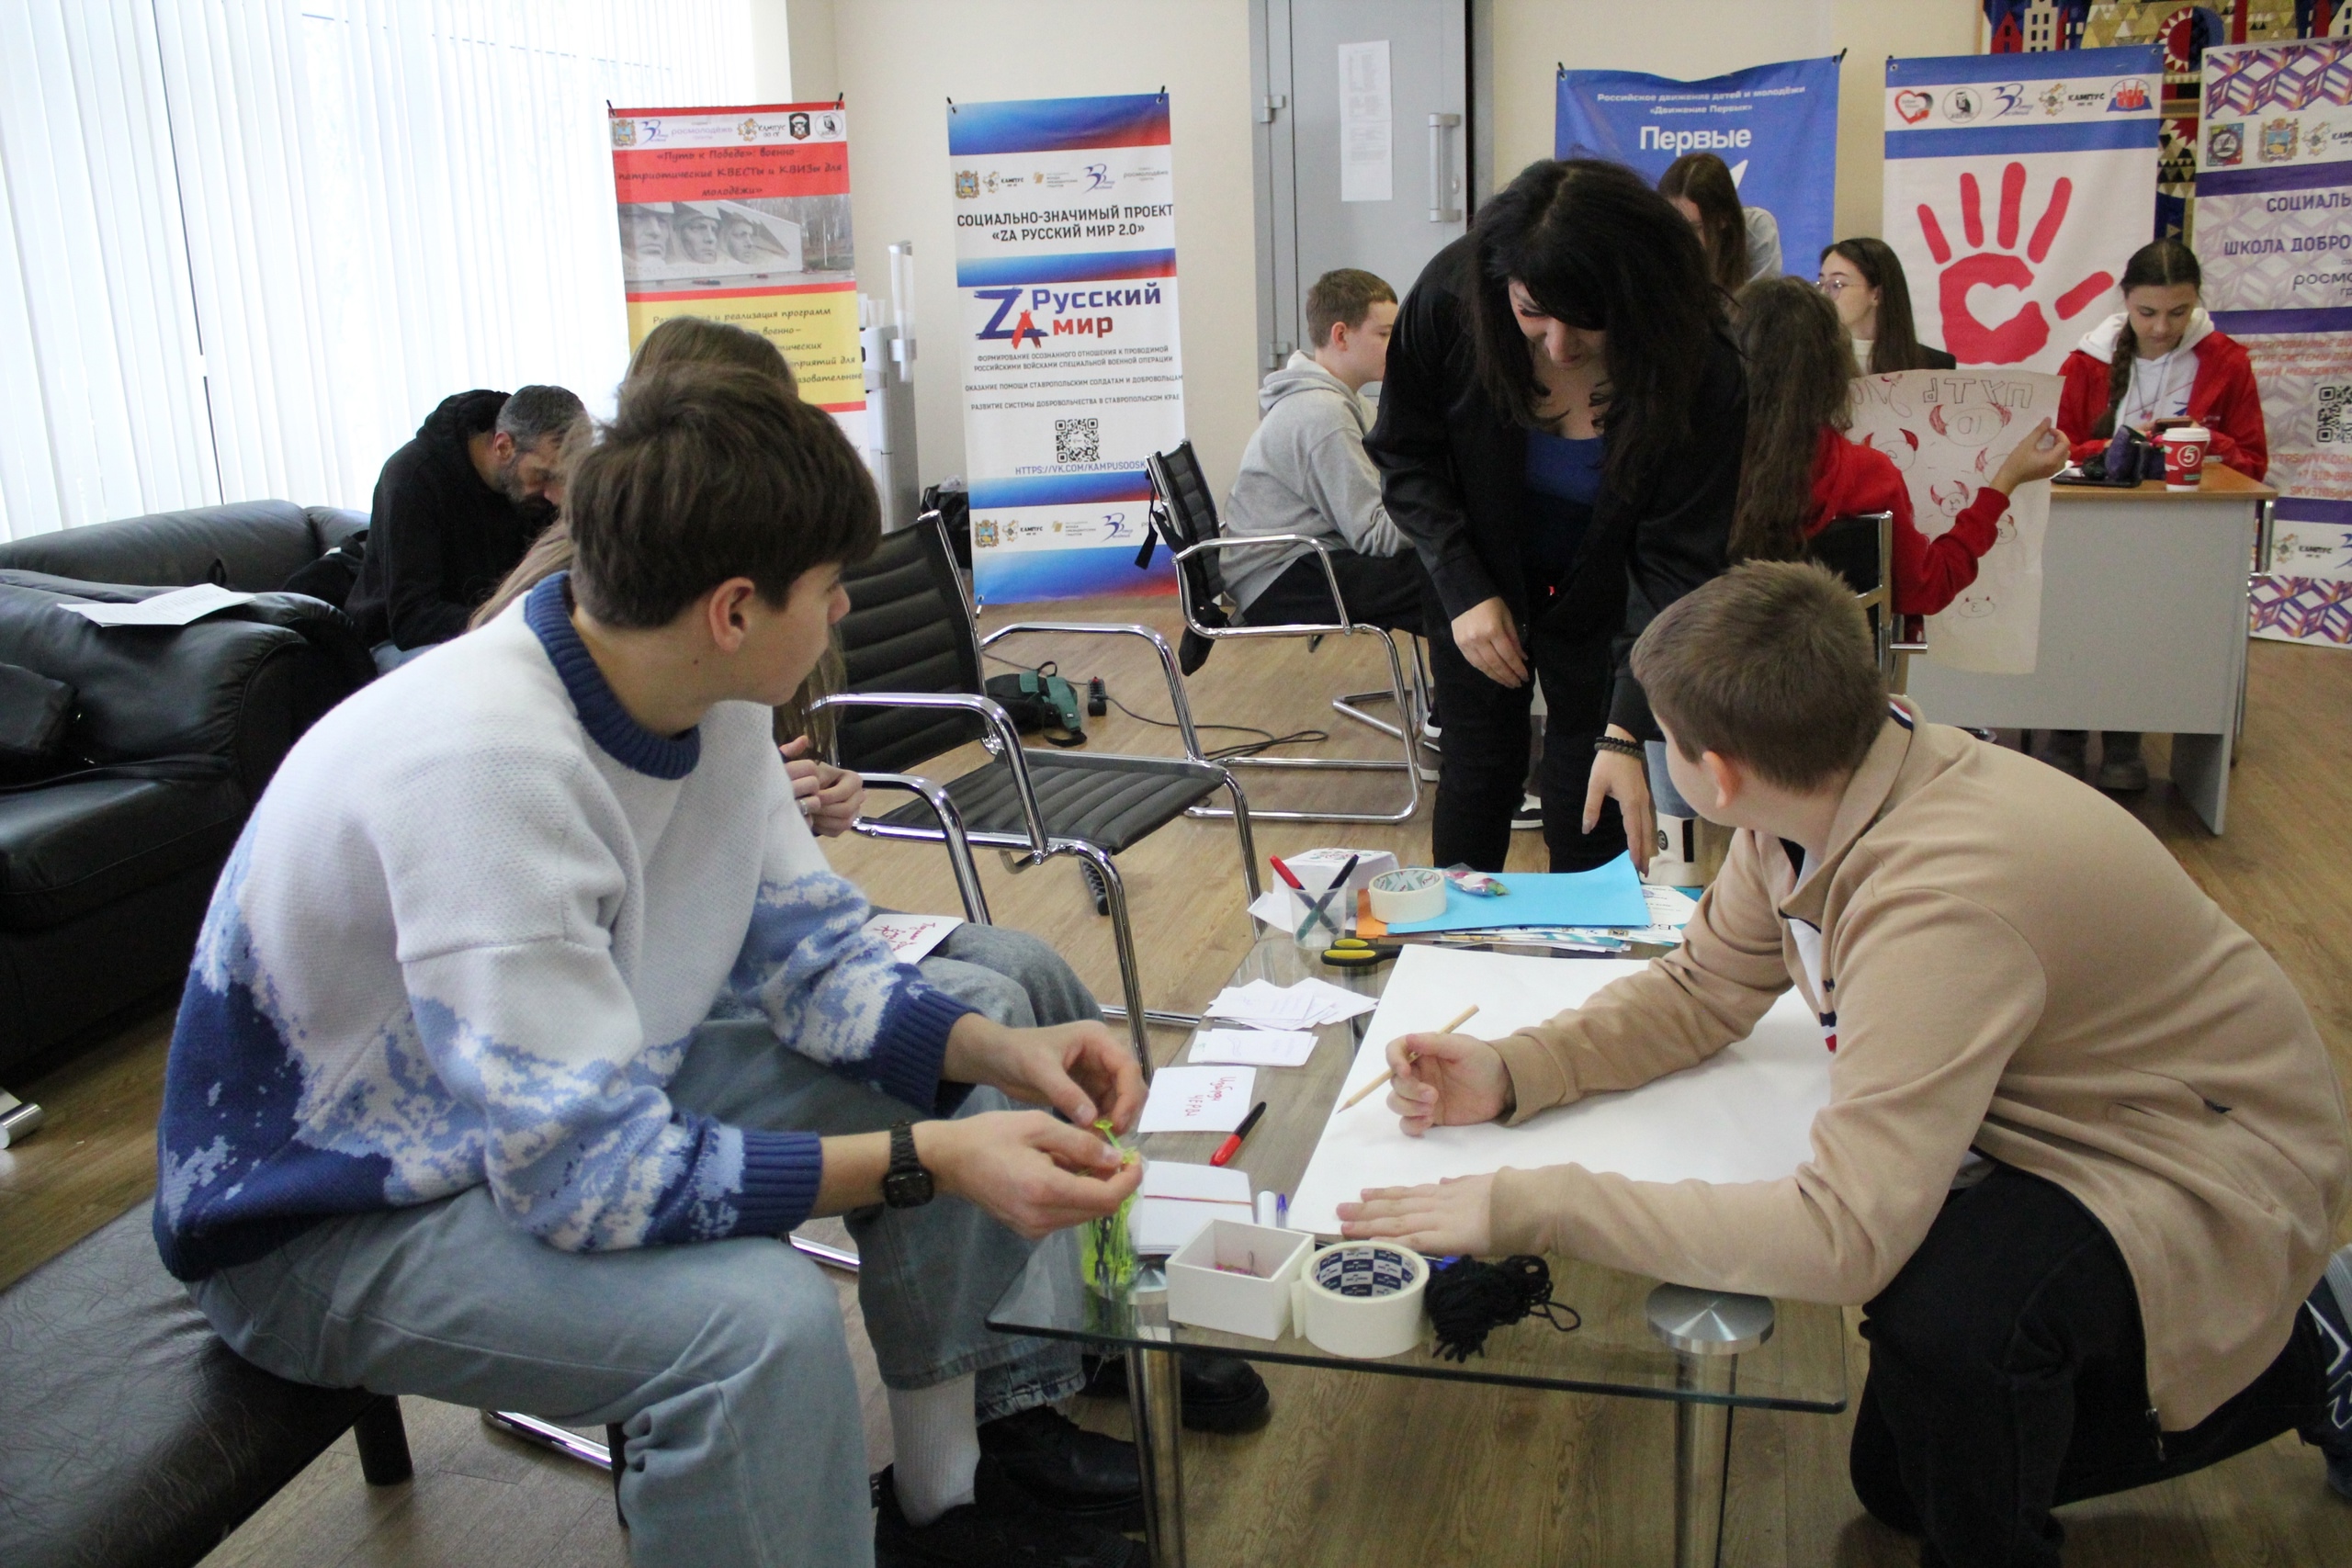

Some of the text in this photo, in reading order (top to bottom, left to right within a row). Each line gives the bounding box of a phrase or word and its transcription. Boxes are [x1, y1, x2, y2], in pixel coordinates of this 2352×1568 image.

[1597, 93, 1657, 102] Российское
[1658, 93, 1710, 103] движение
[1713, 90, 1742, 101] детей
[1753, 85, 1806, 98] молодёжи
[2068, 92, 2105, 102] КАМПУС
[1650, 104, 1753, 115] «Движение Первых»
[1639, 126, 1752, 157] Первые
[657, 151, 695, 162] «Путь
[709, 148, 752, 159] Победе»
[618, 170, 713, 183] патриотические
[718, 167, 764, 176] КВЕСТы
[779, 164, 820, 174] КВИЗы
[824, 162, 842, 172] для
[2267, 193, 2351, 212] СОЦИАЛЬ
[957, 204, 1173, 228] СОЦИАЛЬНО-ЗНАЧИМЫЙ ПРОЕКТ
[1022, 224, 1081, 241] РУССКИЙ
[1086, 225, 1114, 237] МИР
[1119, 223, 1145, 236] 2.0»
[2224, 235, 2351, 255] ШКОЛА ДОБРО
[1032, 282, 1161, 314] Русский
[724, 312, 778, 321] реализация
[782, 309, 831, 320] программ
[1053, 316, 1113, 338] мир
[840, 355, 855, 365] для
[978, 353, 1030, 362] ФОРМИРОВАНИЕ
[1031, 350, 1077, 360] ОСОЗНАННОГО
[1078, 349, 1117, 358] ОТНОШЕНИЯ
[1124, 345, 1169, 355] ПРОВОДИМОЙ
[974, 355, 1173, 372] РОССИЙСКИМИ ВОЙСКАМИ СПЕЦИАЛЬНОЙ ВОЕННОЙ ОПЕРАЦИИ
[965, 383, 998, 392] ОКАЗАНИЕ
[999, 382, 1028, 390] ПОМОЩИ
[1029, 378, 1089, 389] СТАВРОПОЛЬСКИМ
[1090, 377, 1125, 386] СОЛДАТАМ
[1132, 374, 1183, 384] ДОБРОВОЛЬЦАМ
[970, 402, 1003, 412] РАЗВИТИЕ
[1004, 401, 1035, 410] СИСТЕМЫ
[1035, 398, 1097, 408] ДОБРОВОЛЬЧЕСТВА
[1104, 394, 1162, 404] СТАВРОПОЛЬСКОМ
[1164, 393, 1180, 401] КРАЕ
[2183, 447, 2197, 463] 5
